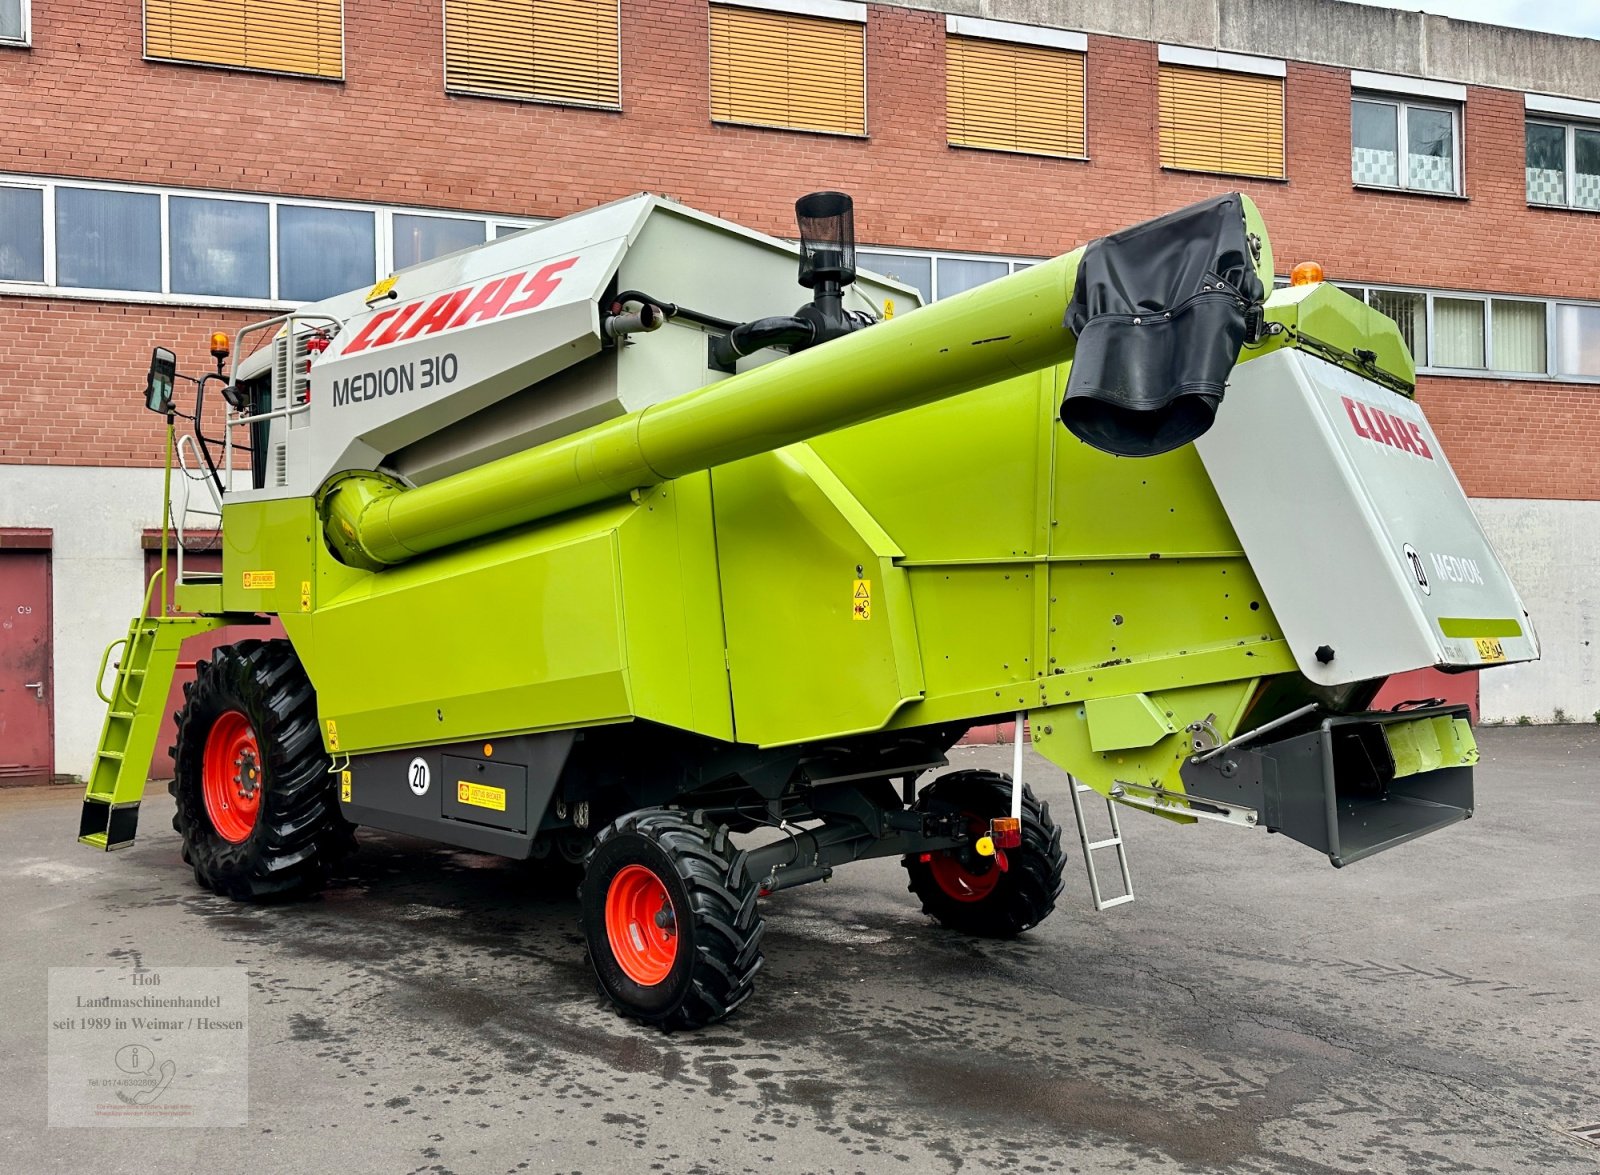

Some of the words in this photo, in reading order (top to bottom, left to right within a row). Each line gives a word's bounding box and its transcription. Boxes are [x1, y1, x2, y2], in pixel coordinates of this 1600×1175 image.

[341, 256, 581, 355] CLAAS
[333, 362, 414, 407] MEDION
[420, 353, 458, 389] 310
[1341, 395, 1434, 460] CLAAS
[1406, 551, 1428, 587] 20
[1430, 552, 1485, 586] MEDION
[413, 764, 426, 788] 20
